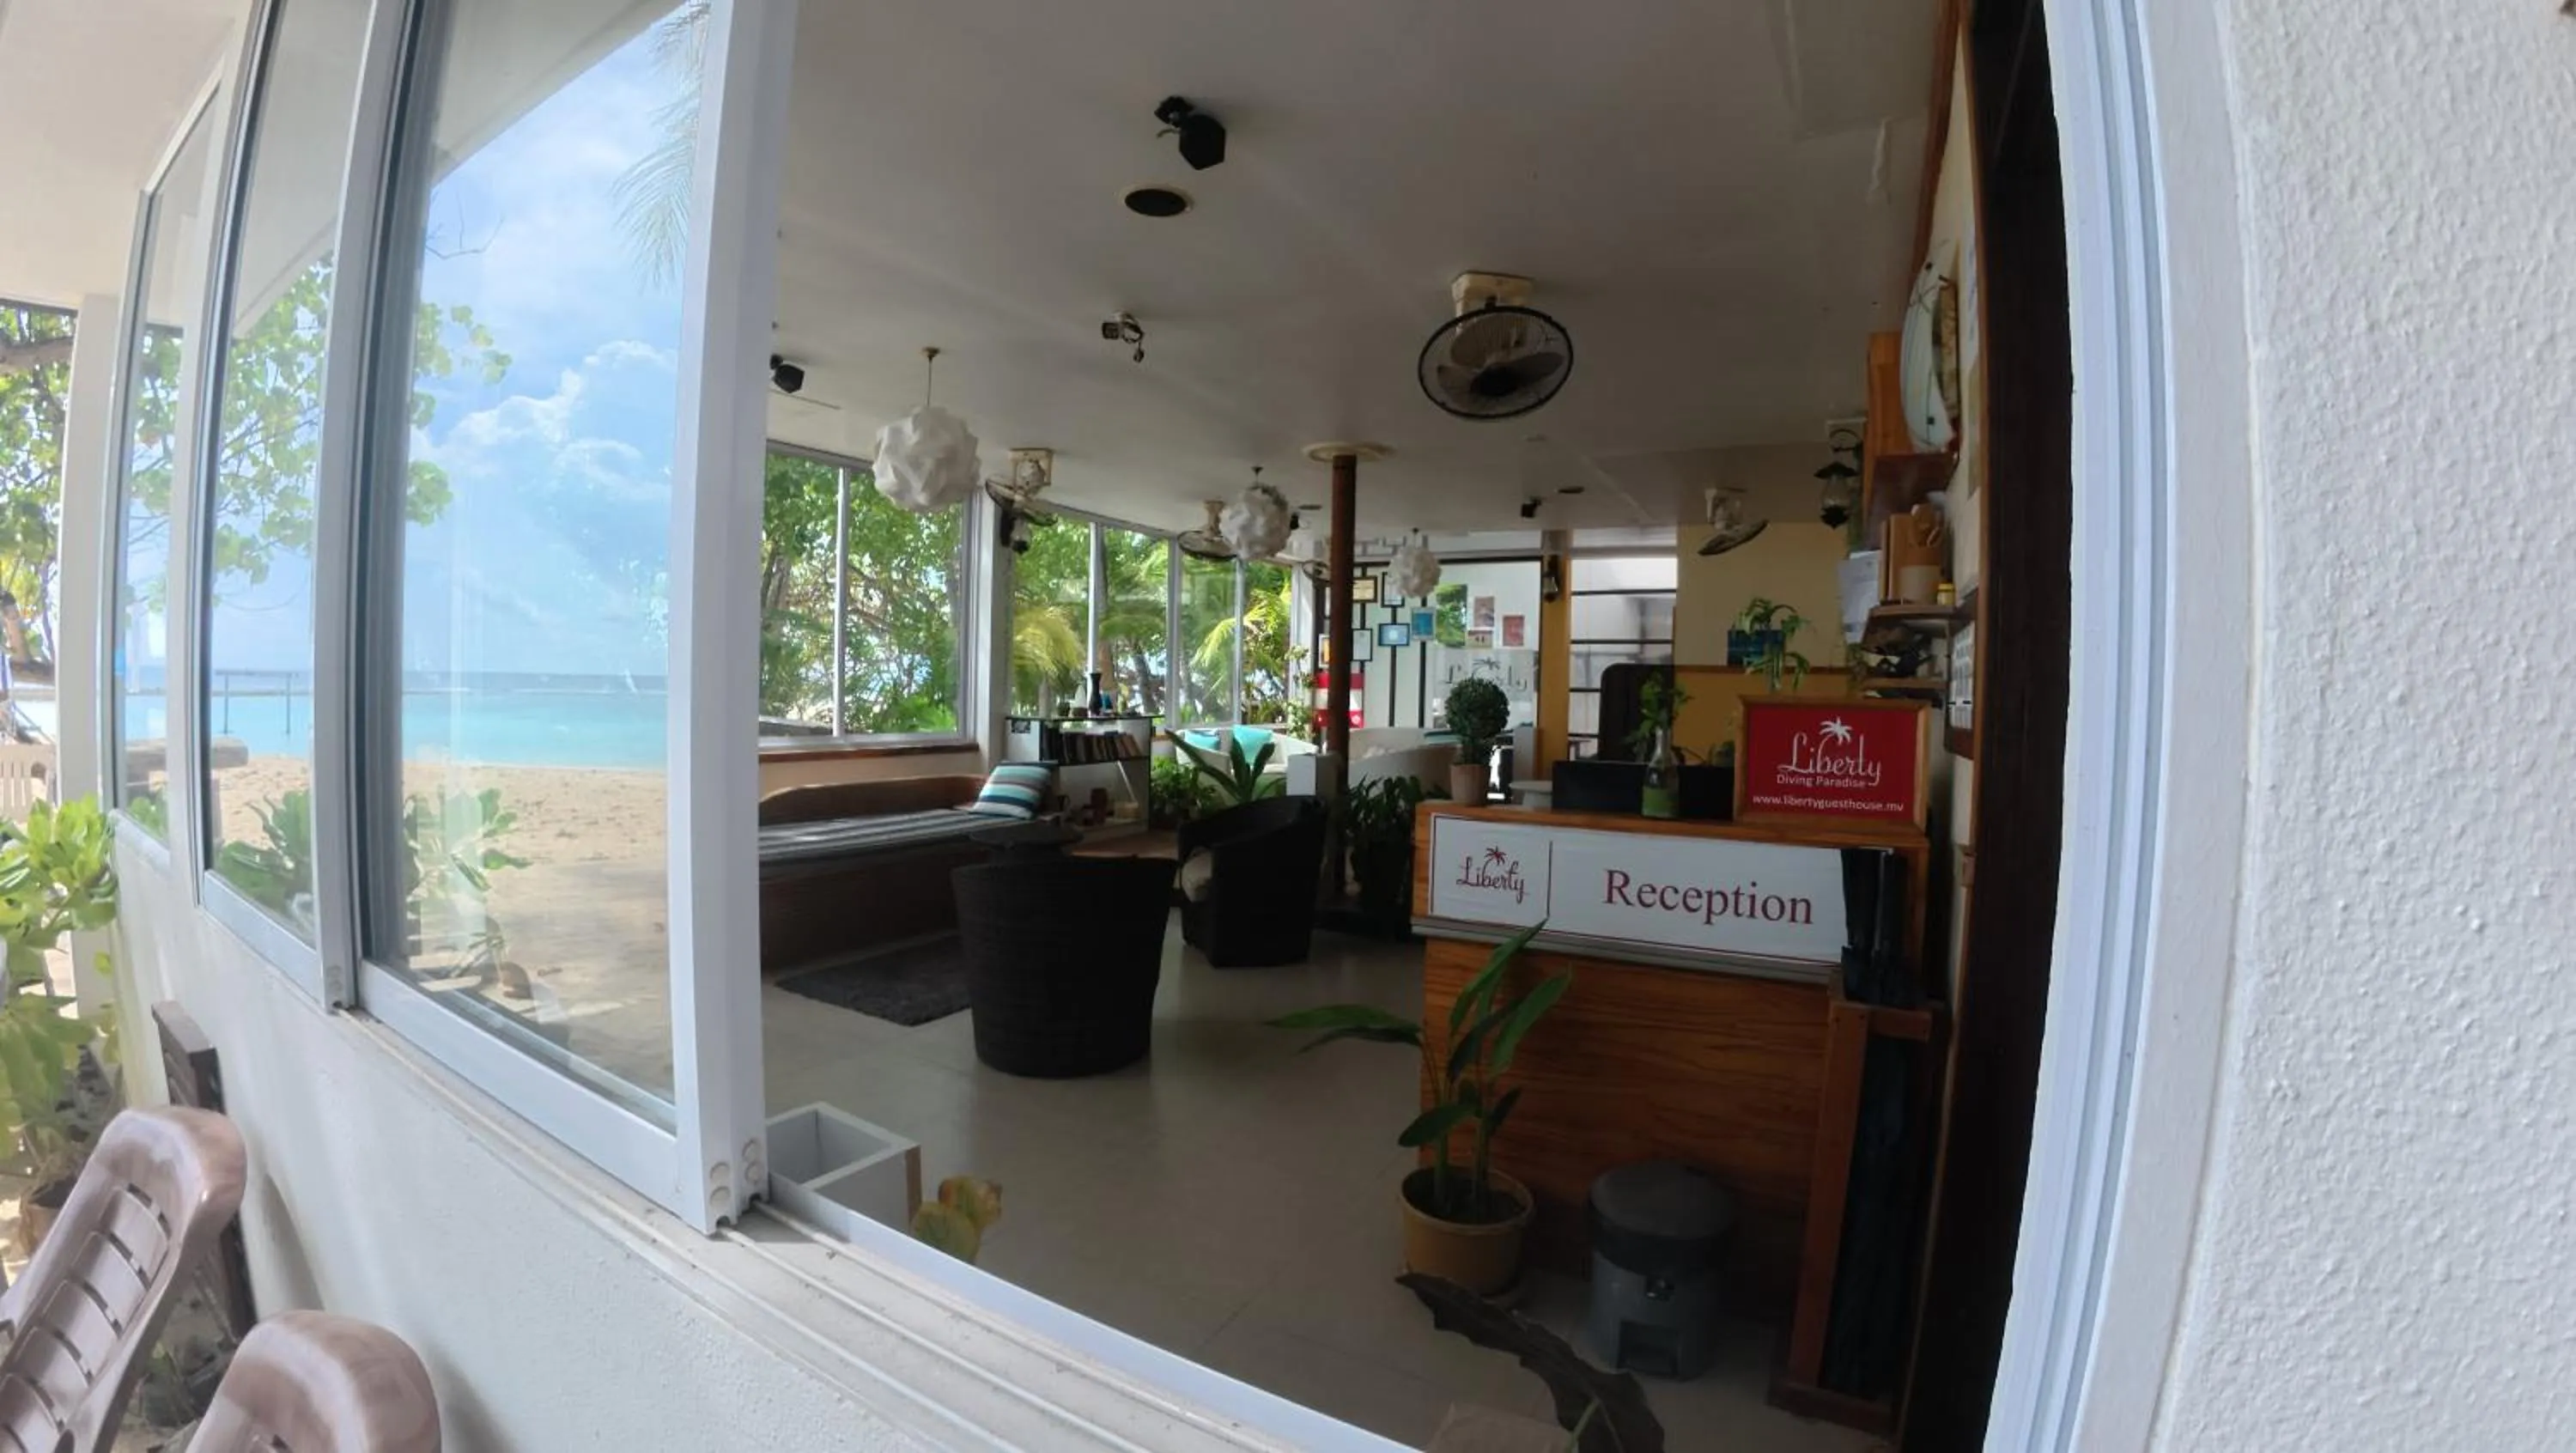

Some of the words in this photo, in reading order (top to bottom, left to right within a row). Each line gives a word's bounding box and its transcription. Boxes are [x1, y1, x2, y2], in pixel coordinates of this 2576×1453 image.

[1777, 731, 1881, 787] Liberty
[1777, 774, 1814, 787] Diving
[1815, 775, 1866, 788] Paradise
[1753, 793, 1905, 812] www.libertyguesthouse.mv
[1455, 855, 1529, 904] Liberty
[1602, 868, 1814, 926] Reception
